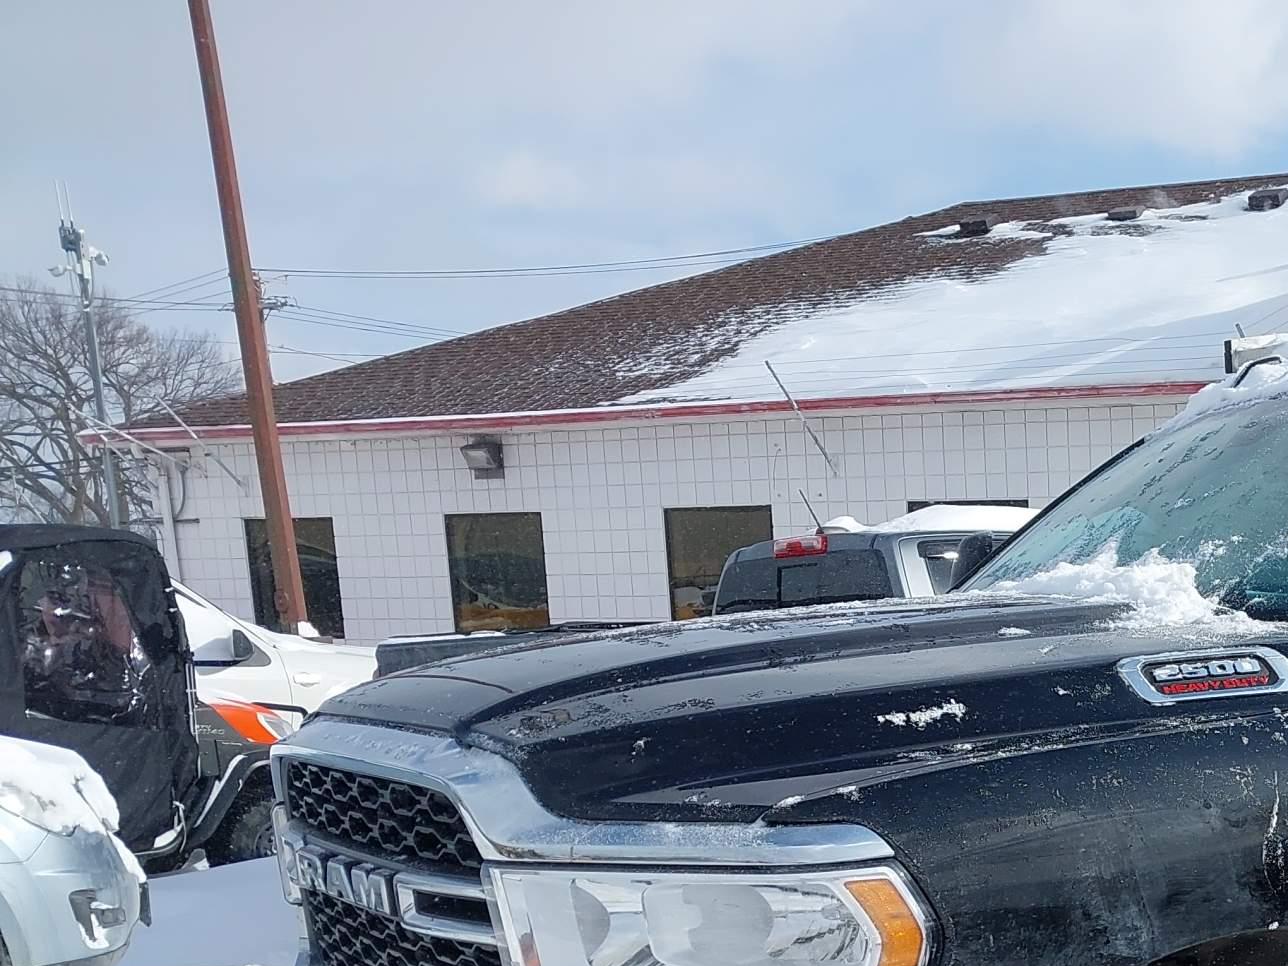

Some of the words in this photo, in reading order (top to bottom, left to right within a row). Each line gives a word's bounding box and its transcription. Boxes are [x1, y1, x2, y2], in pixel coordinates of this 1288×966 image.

[1152, 657, 1262, 682] 2500
[1162, 679, 1220, 694] HEAVY
[1222, 674, 1270, 689] DUTY
[295, 847, 391, 916] RAM
